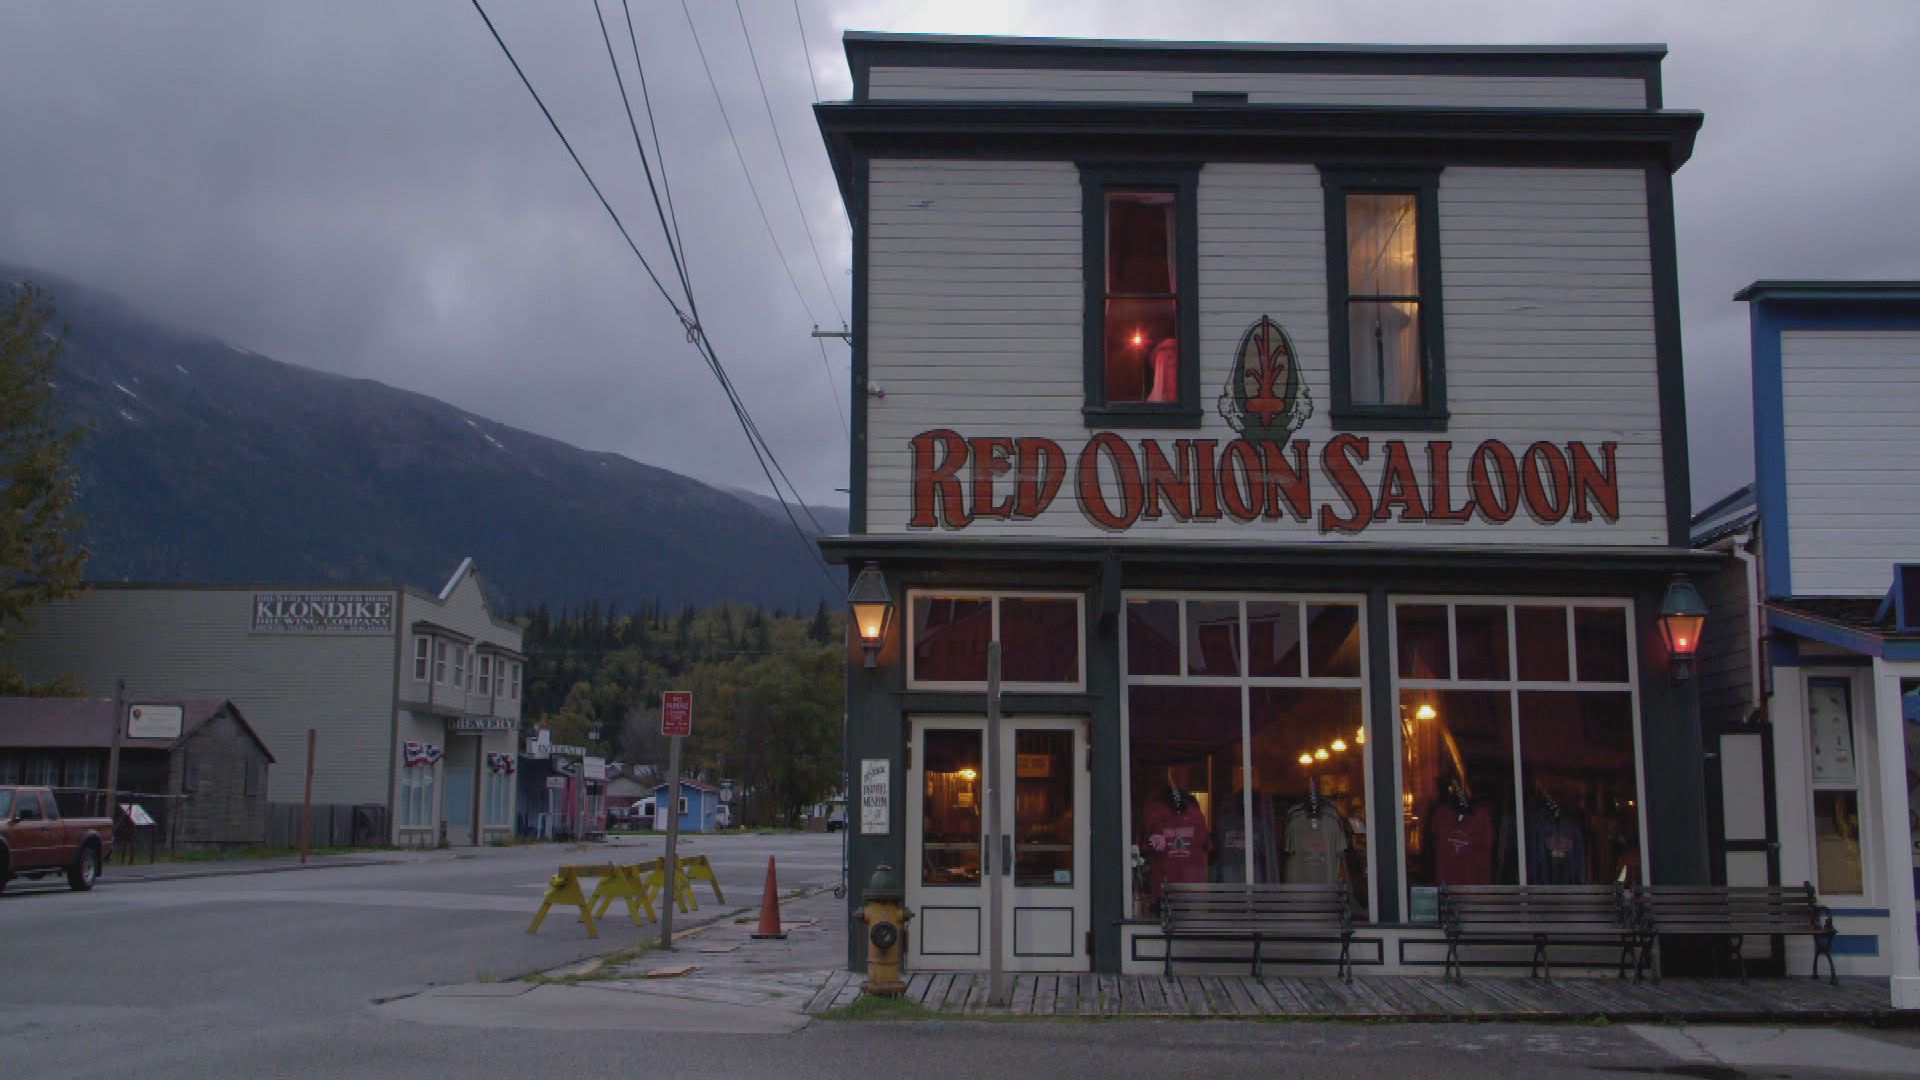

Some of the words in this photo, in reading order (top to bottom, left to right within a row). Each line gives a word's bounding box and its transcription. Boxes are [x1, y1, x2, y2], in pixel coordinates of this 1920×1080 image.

[907, 428, 1066, 531] RED
[1074, 432, 1312, 533] ONION
[1318, 433, 1620, 535] SALOON
[257, 602, 391, 618] KLONDIKE
[448, 717, 513, 729] BREWERY
